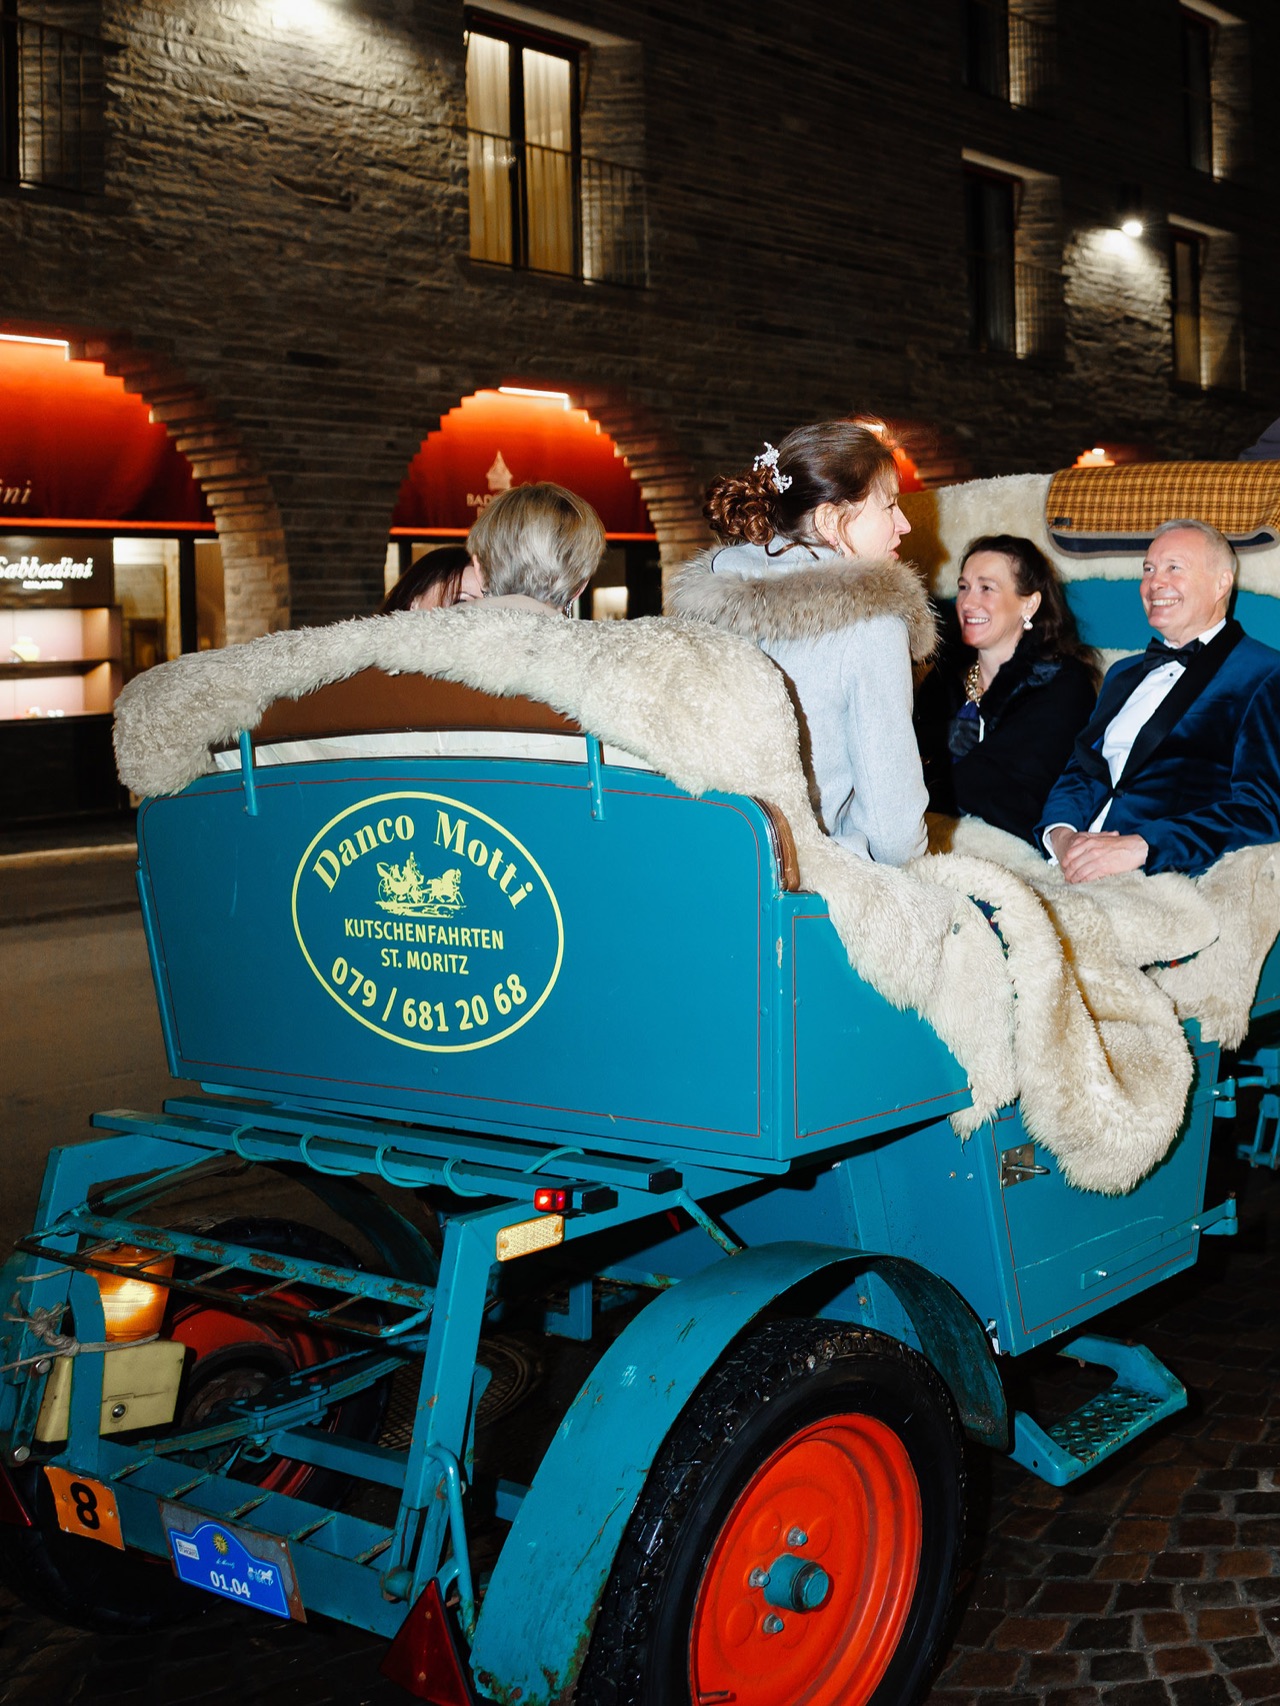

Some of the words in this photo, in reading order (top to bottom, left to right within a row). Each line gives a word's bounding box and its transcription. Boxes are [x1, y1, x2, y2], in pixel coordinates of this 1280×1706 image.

[312, 814, 415, 893] Danco
[433, 809, 534, 910] Motti
[344, 918, 504, 950] KUTSCHENFAHRTEN
[380, 948, 402, 968] ST.
[406, 950, 469, 975] MORITZ
[331, 956, 377, 1007] 079
[402, 998, 449, 1032] 681
[455, 994, 489, 1031] 20
[493, 973, 528, 1015] 68
[70, 1481, 100, 1530] 8
[210, 1570, 251, 1599] 01.04
